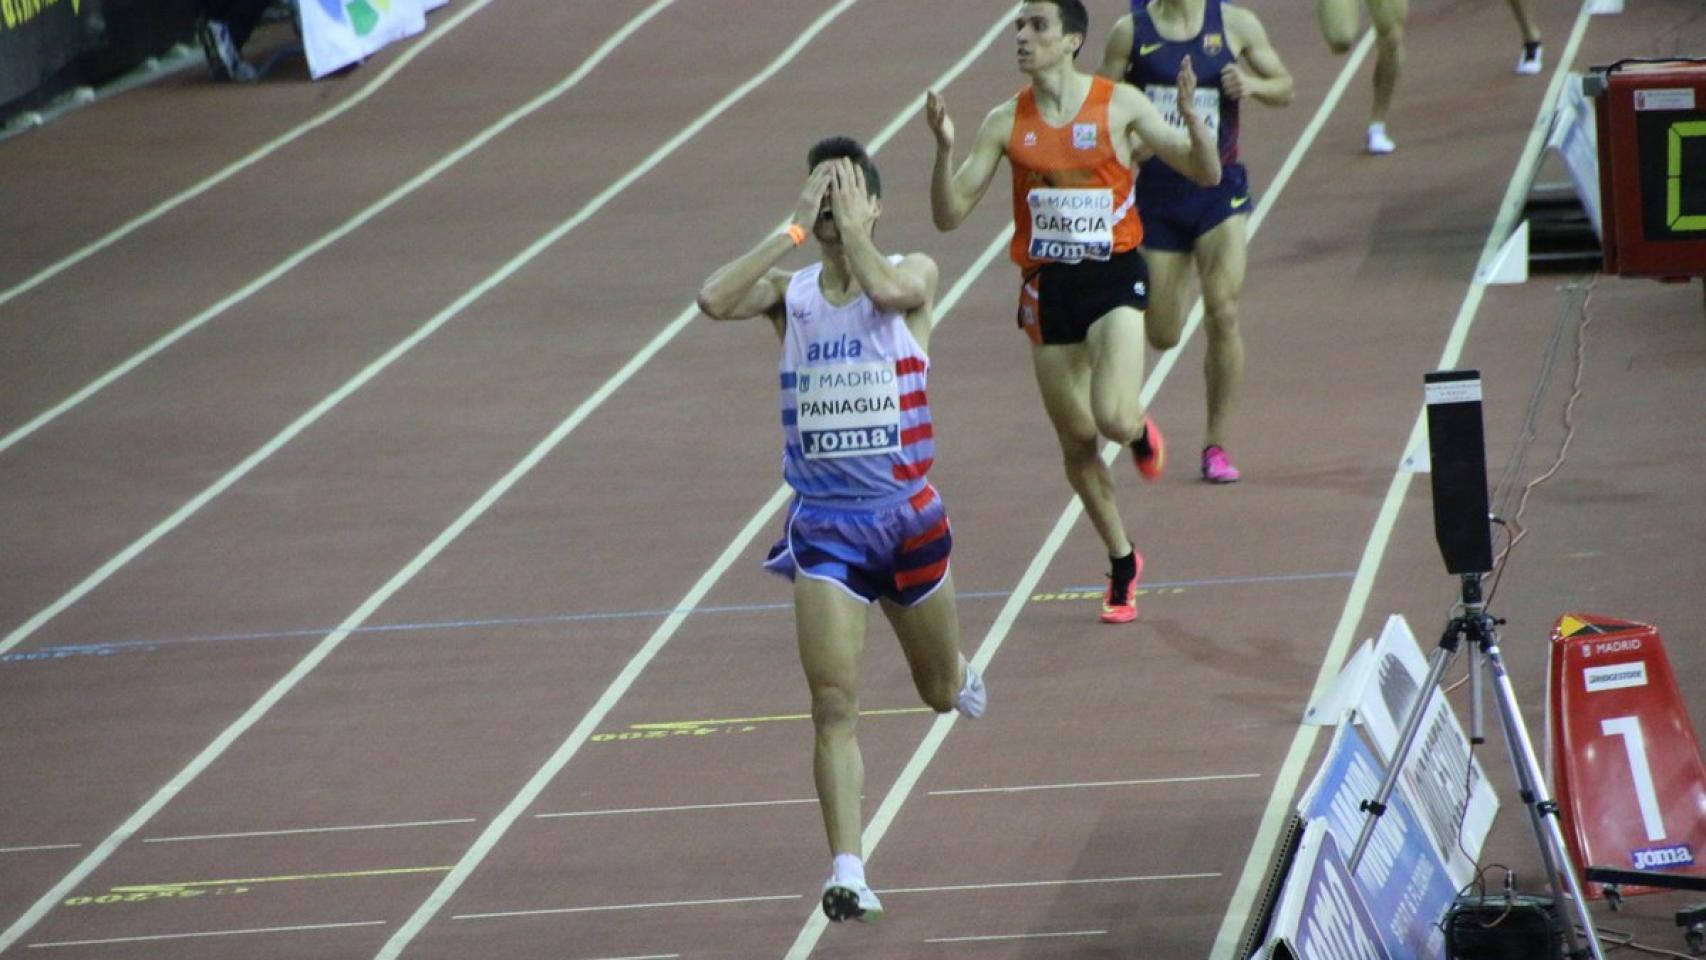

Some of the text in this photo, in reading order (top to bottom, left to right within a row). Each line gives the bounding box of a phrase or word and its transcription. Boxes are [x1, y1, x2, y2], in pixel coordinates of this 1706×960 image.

[1047, 195, 1111, 209] MADRID
[1035, 215, 1107, 233] GARCIA
[807, 333, 863, 361] aula
[819, 369, 895, 388] MADRID
[801, 396, 896, 417] PANIAGUA
[1596, 639, 1642, 654] MADRID
[1601, 715, 1667, 841] 1
